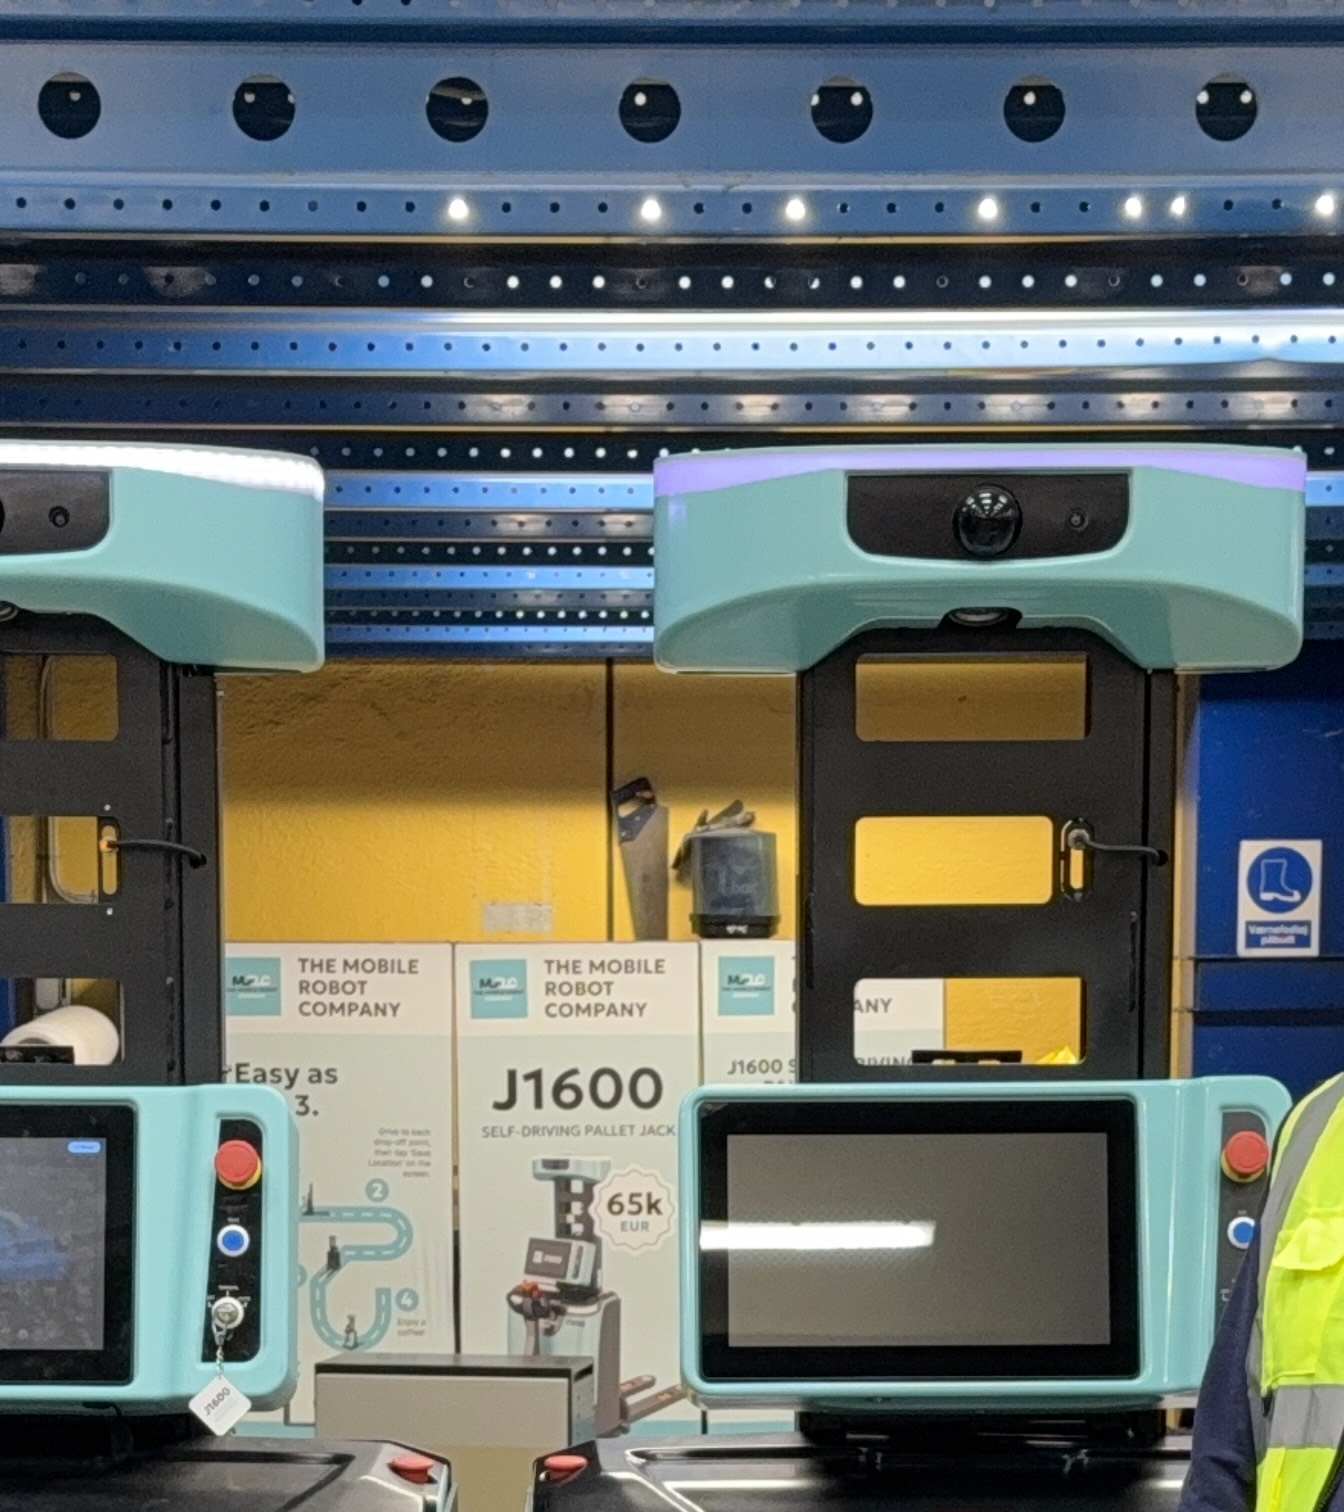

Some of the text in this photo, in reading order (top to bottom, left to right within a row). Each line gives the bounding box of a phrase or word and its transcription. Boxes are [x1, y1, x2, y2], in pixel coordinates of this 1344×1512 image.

[298, 958, 419, 975] THE MOBILE
[544, 959, 666, 975] THE MOBILE
[298, 980, 368, 996] ROBOT
[544, 981, 615, 996] ROBOT
[298, 1002, 401, 1018] COMPANY
[544, 1003, 648, 1018] COMPANY
[727, 1058, 783, 1075] J1600
[235, 1062, 339, 1090] Easy as
[492, 1067, 664, 1111] J1600
[481, 1124, 677, 1139] SELF-DRIVING PALLET JACK
[371, 1183, 384, 1198] 2
[607, 1192, 664, 1216] 65k
[620, 1221, 650, 1232] EUR
[401, 1291, 413, 1307] 4
